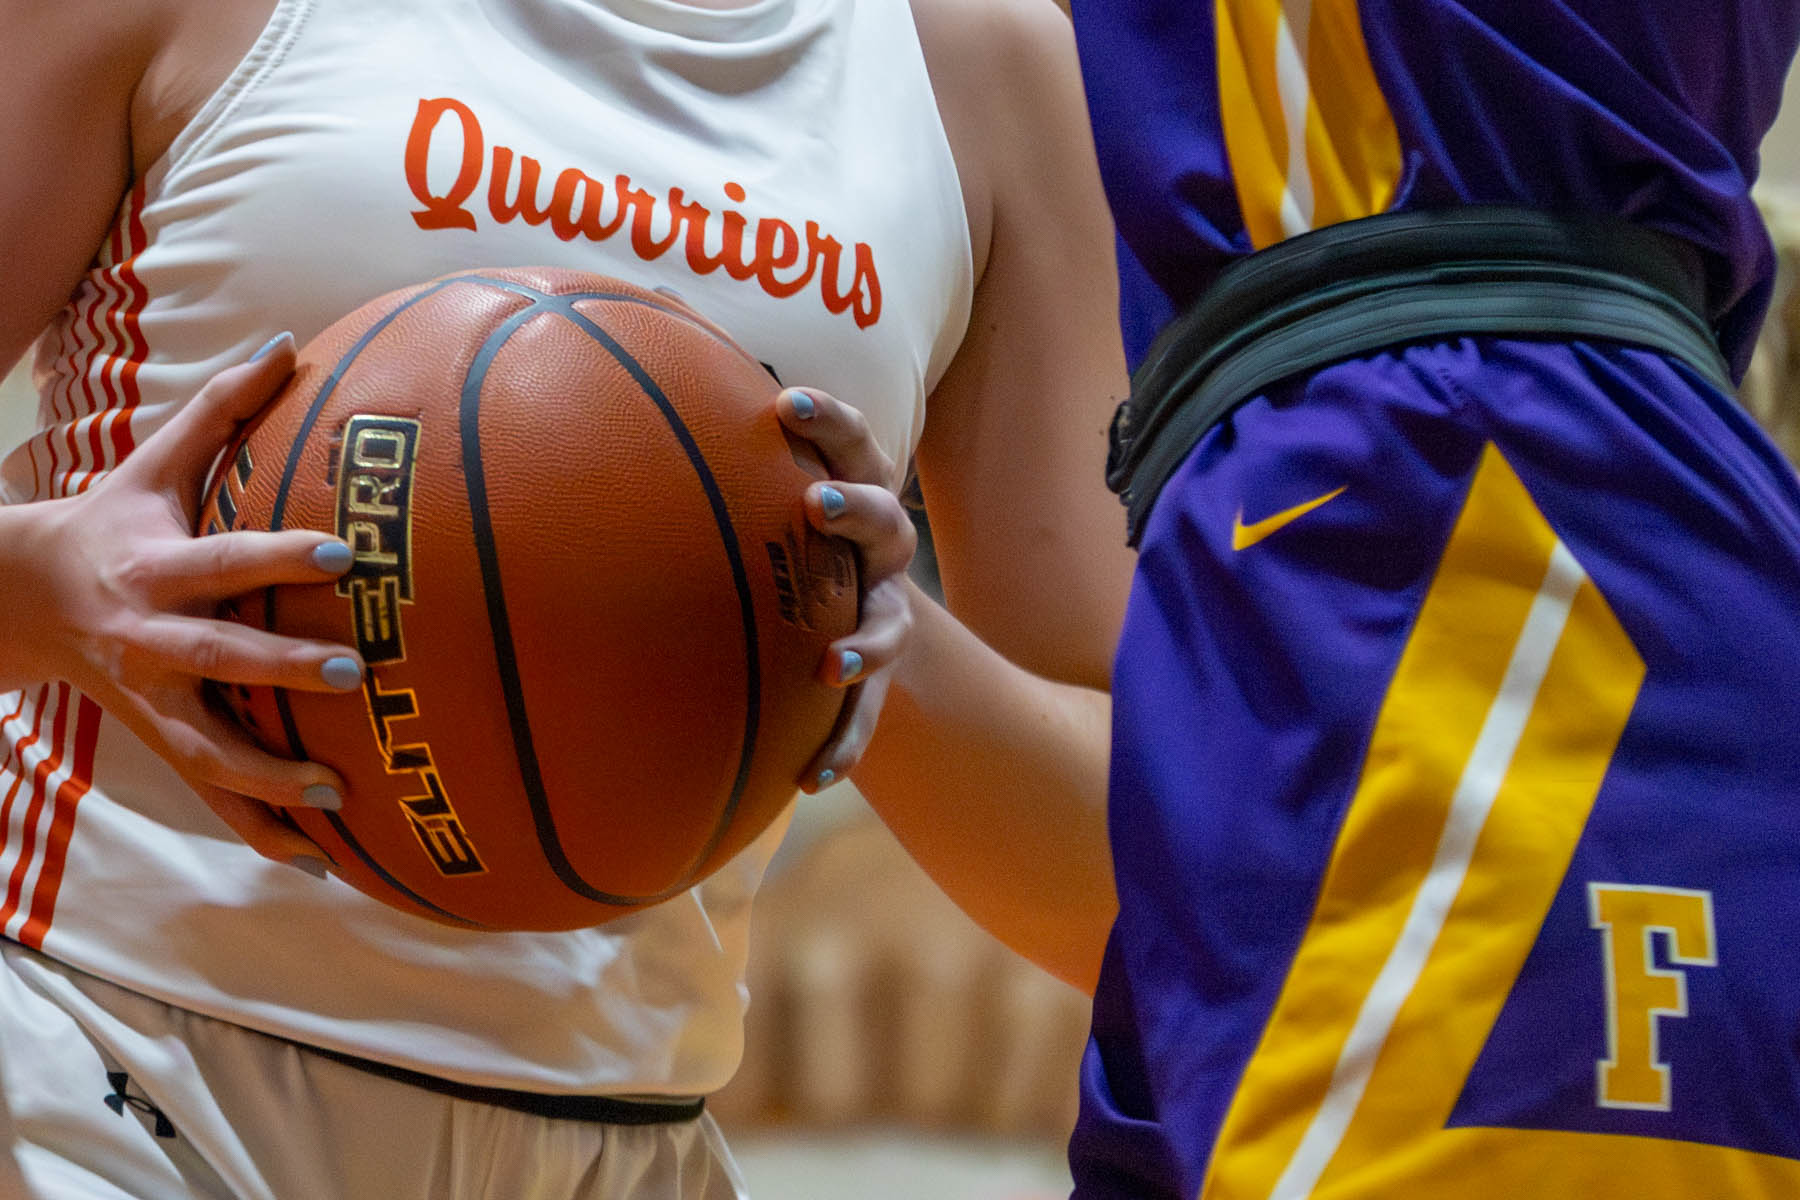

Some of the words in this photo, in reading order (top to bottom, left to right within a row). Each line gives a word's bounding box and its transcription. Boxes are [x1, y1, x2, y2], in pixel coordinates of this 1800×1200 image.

[402, 96, 884, 331] Quarriers
[345, 425, 409, 569] PRO
[348, 575, 490, 878] ELITE
[1586, 881, 1719, 1112] F
